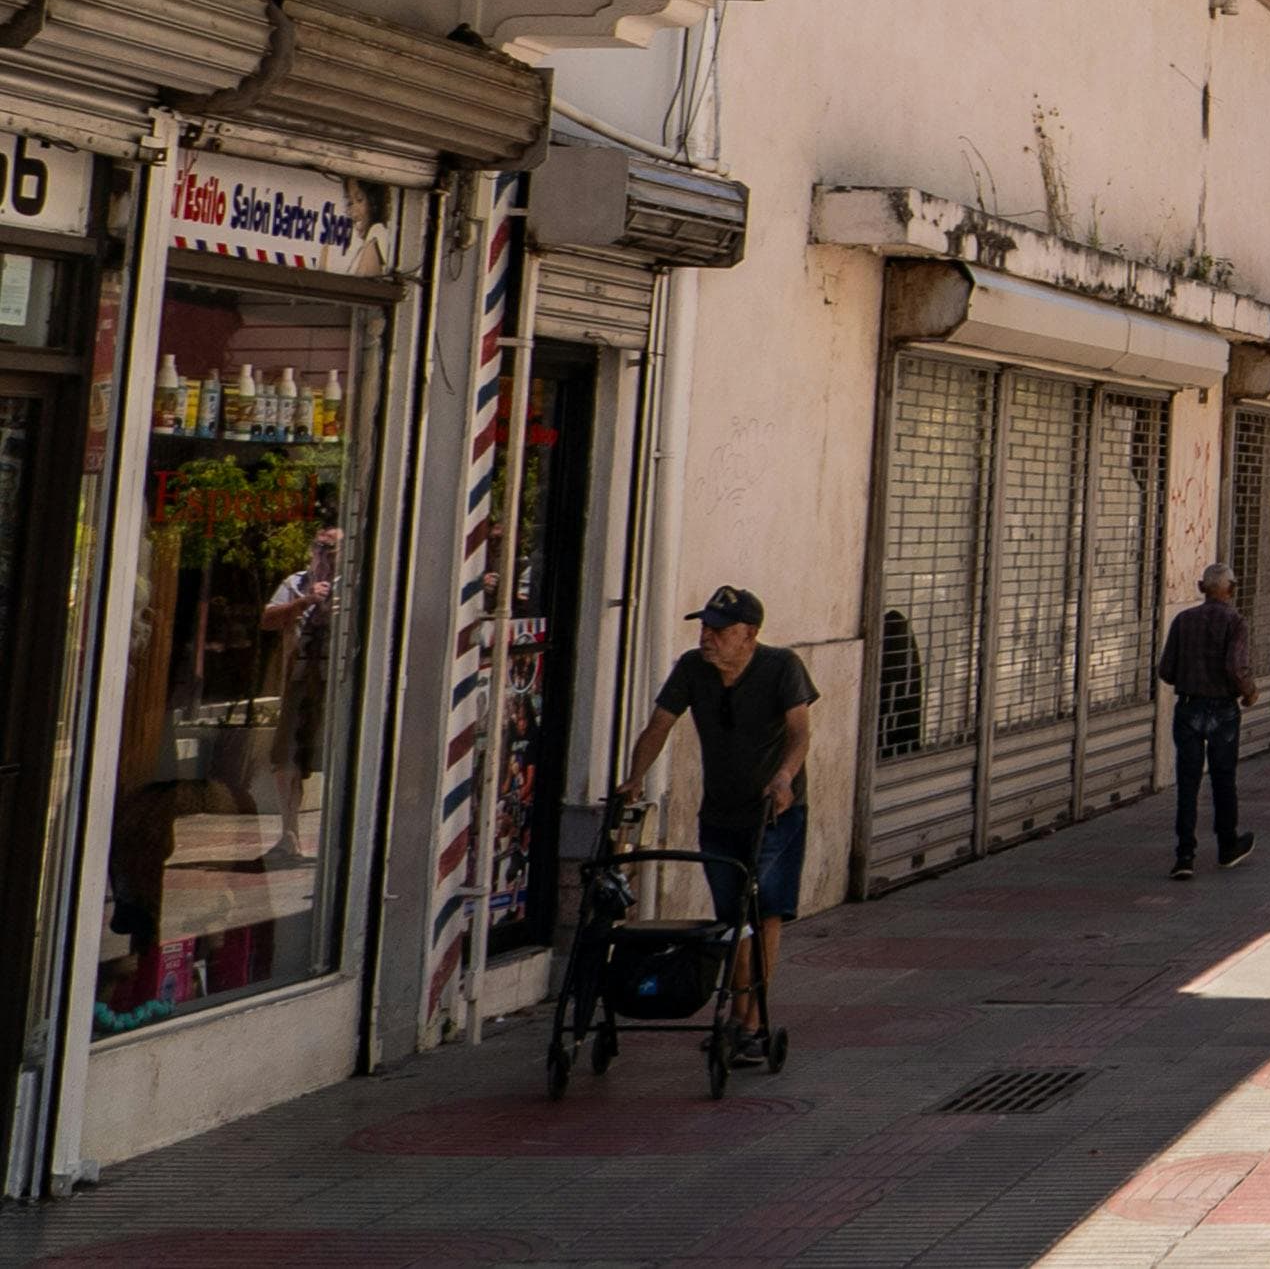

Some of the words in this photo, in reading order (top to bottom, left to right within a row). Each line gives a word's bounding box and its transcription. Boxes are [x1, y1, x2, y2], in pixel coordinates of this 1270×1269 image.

[0, 134, 48, 217] 6
[183, 173, 226, 227] Estilo
[272, 191, 319, 242] Barber
[319, 201, 353, 257] Shop
[152, 470, 319, 539] Especial
